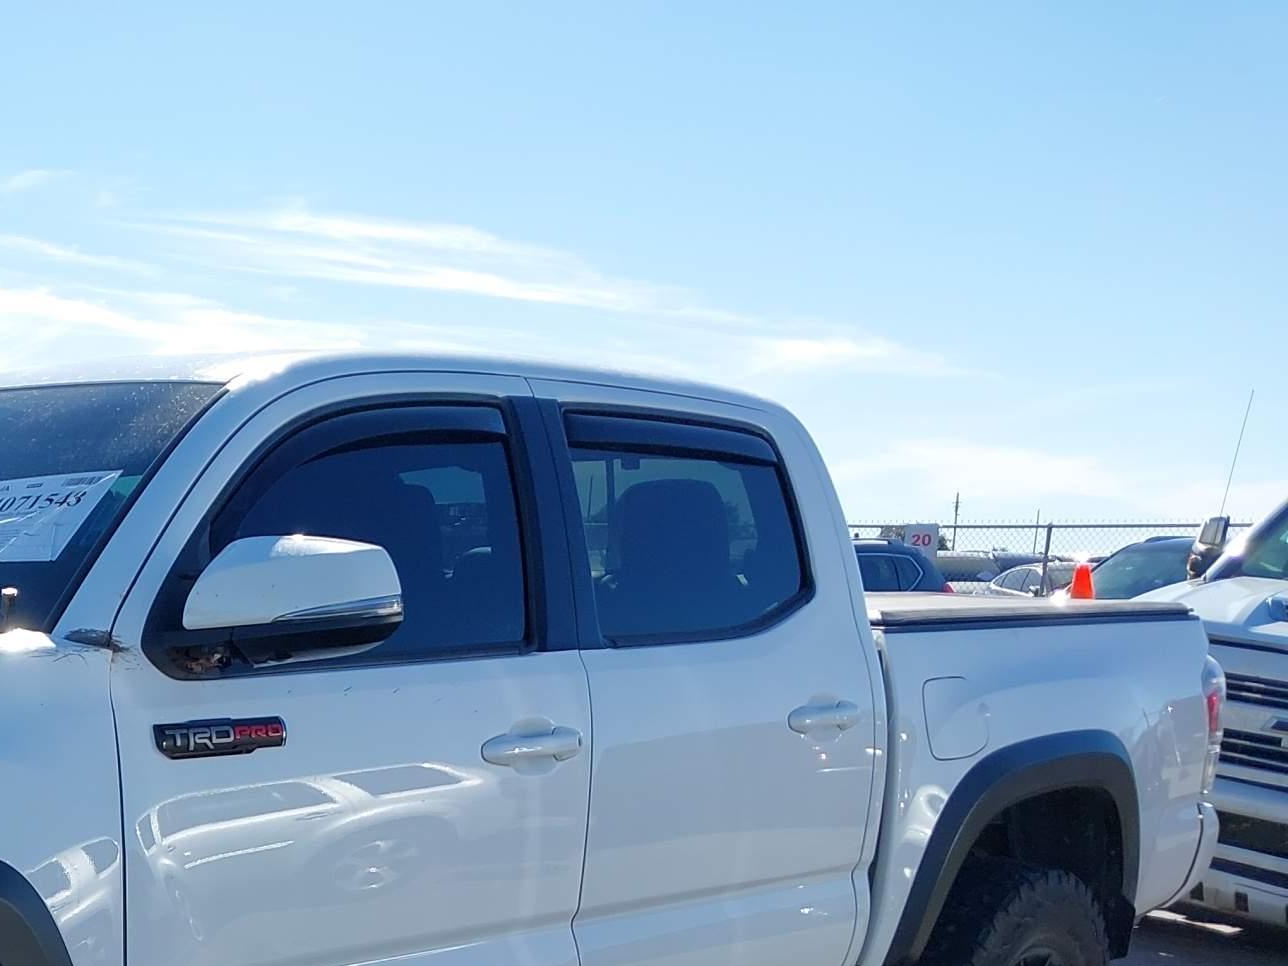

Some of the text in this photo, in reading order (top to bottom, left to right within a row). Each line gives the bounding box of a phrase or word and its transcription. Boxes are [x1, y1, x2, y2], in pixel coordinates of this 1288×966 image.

[911, 534, 932, 547] 20
[165, 724, 282, 751] TRD PRO
